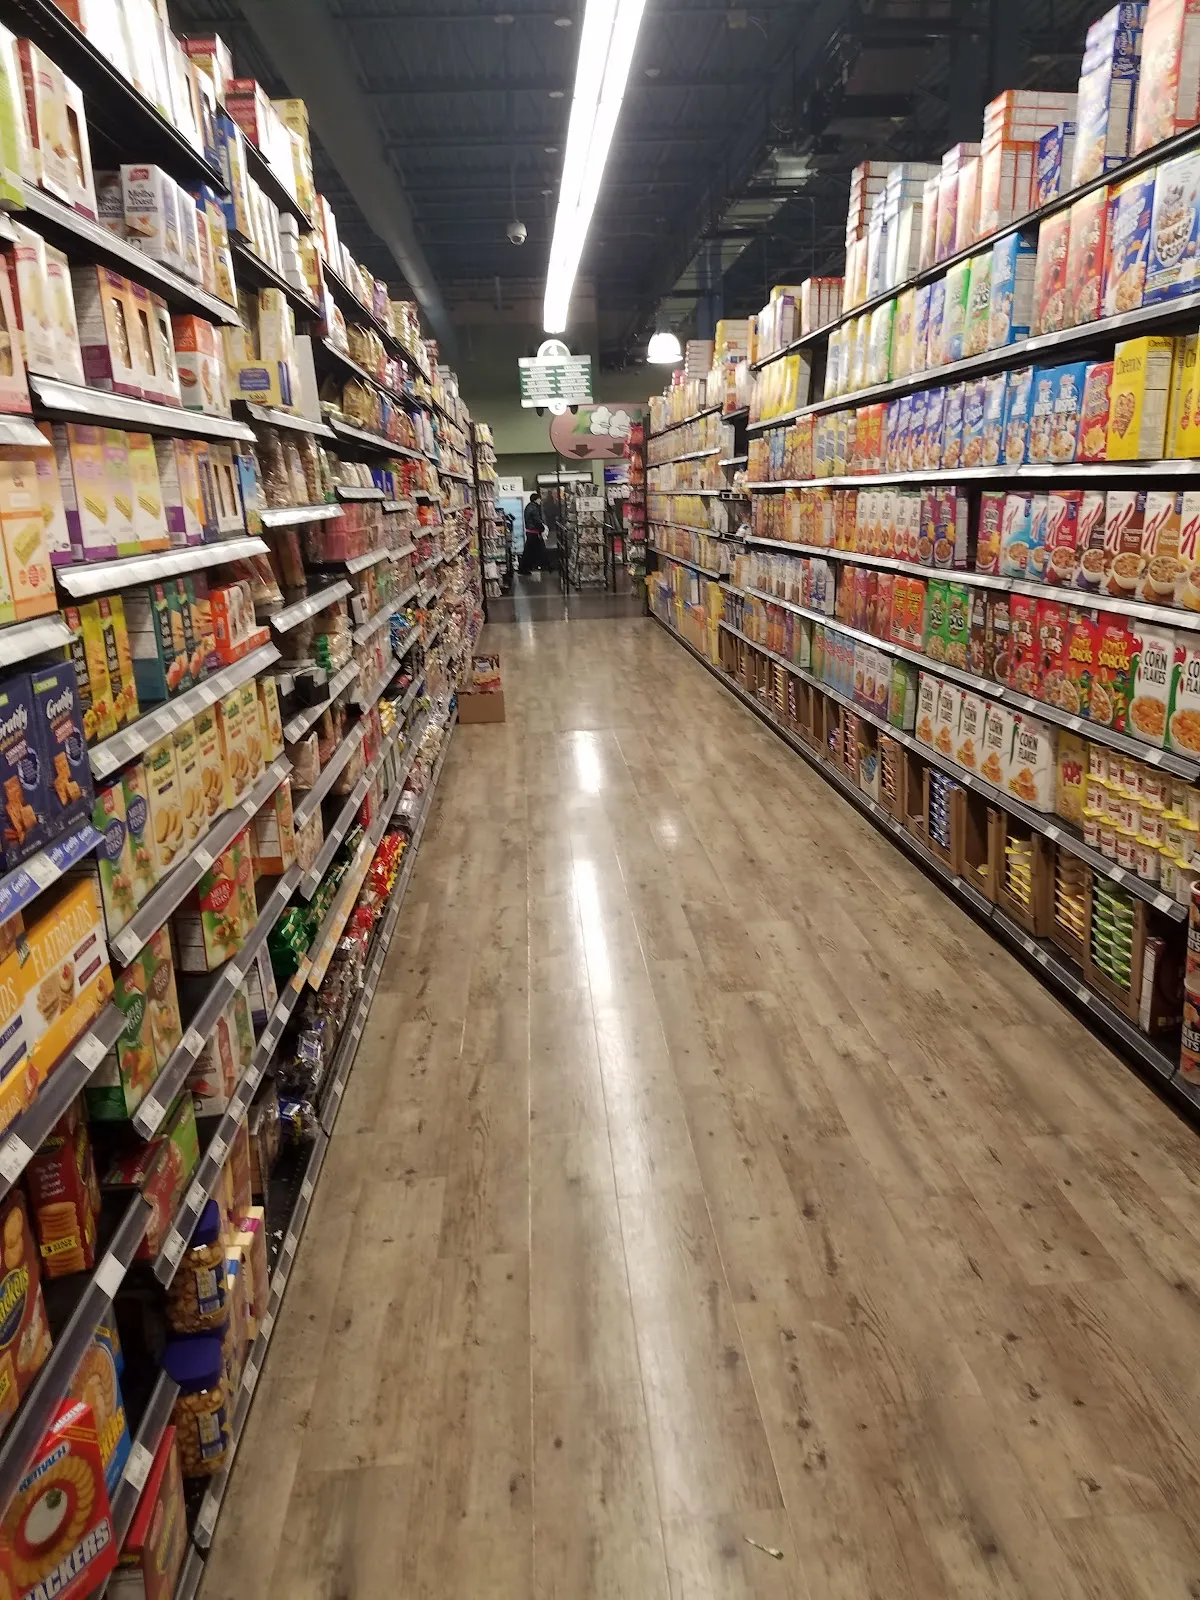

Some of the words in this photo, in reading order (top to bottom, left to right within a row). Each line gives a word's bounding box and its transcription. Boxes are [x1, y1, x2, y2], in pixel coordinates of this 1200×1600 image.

[1106, 502, 1133, 552] K
[1143, 504, 1172, 555] K
[1102, 638, 1128, 656] HONEY
[1098, 650, 1130, 671] SMACKS
[1144, 650, 1168, 671] CORN
[1188, 660, 1200, 679] CO
[1142, 666, 1167, 685] FLAKES
[1185, 677, 1200, 695] FLA
[0, 703, 28, 741] ratify
[1019, 732, 1039, 751] CORN
[1018, 746, 1038, 765] FLAKES
[31, 900, 95, 978] FLATBREADS
